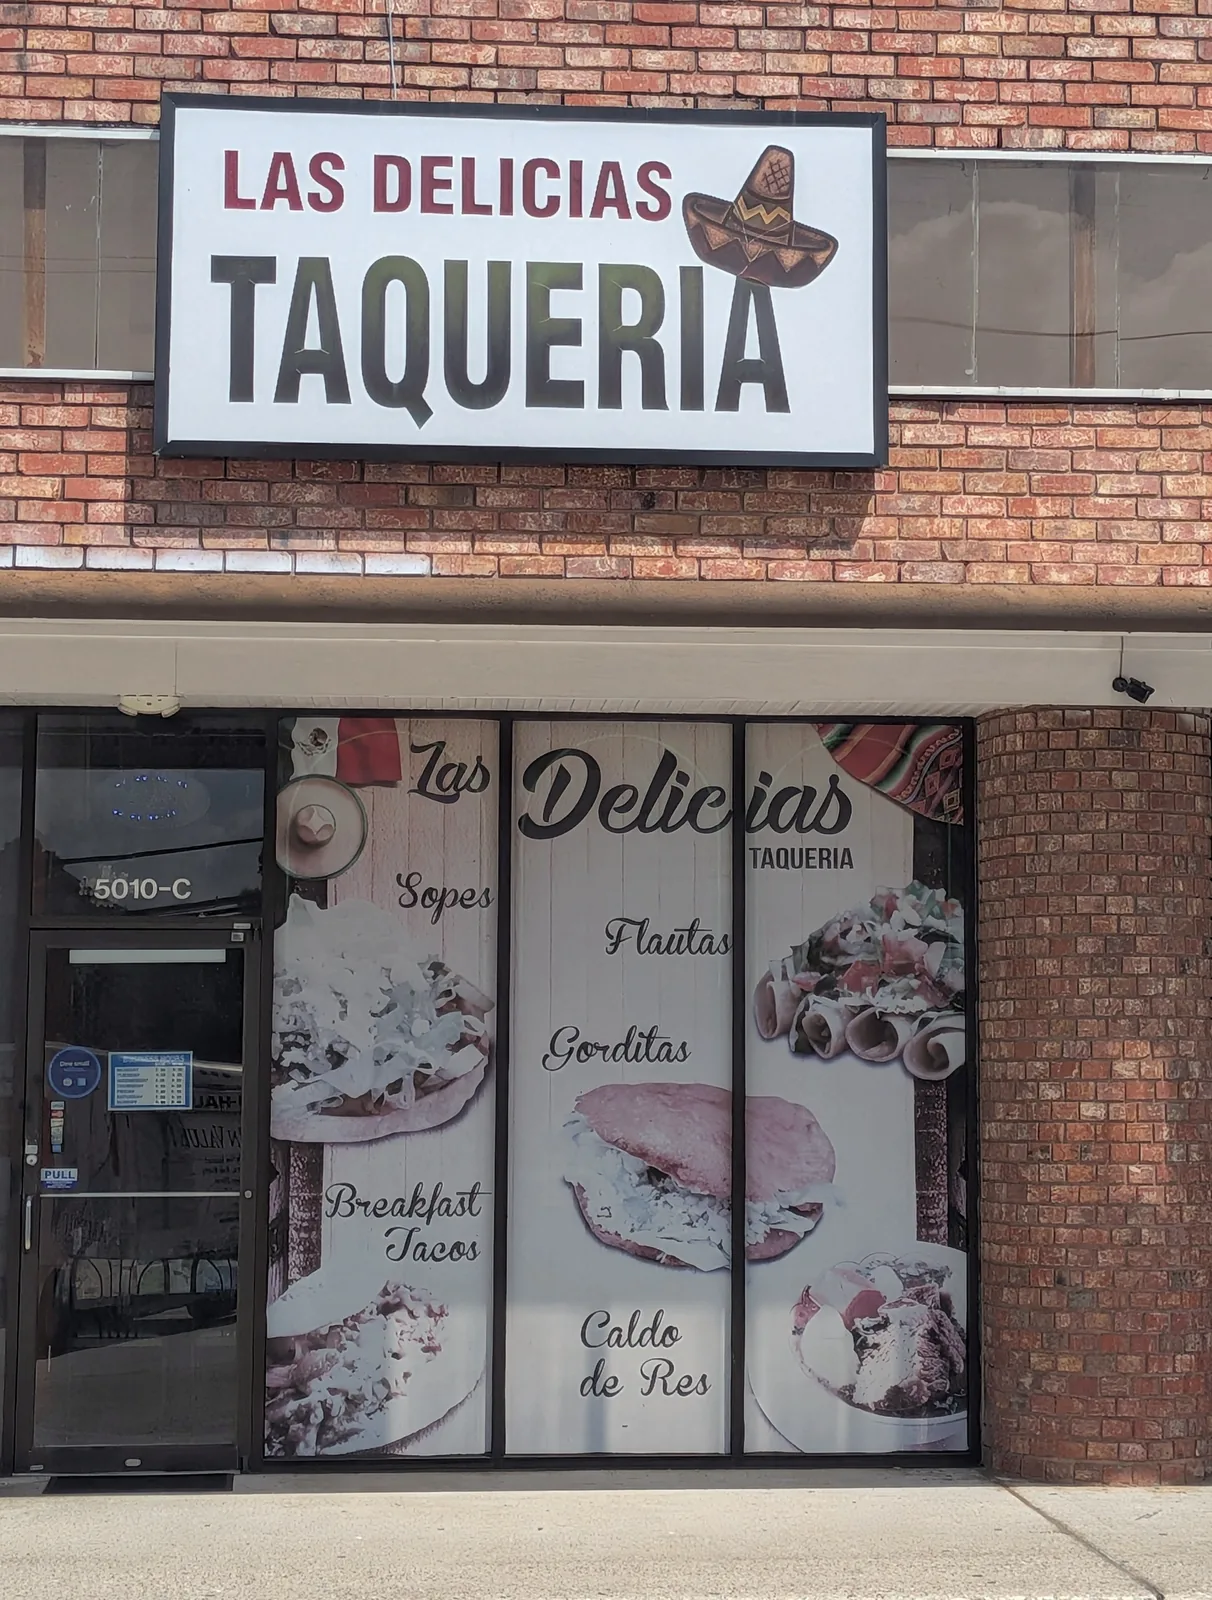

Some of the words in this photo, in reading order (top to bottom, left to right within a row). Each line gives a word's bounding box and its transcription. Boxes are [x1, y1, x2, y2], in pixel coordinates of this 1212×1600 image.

[225, 150, 345, 212] LAS
[374, 155, 672, 221] DELICIAS
[211, 255, 791, 429] TAQUERIA
[407, 741, 491, 804] Las
[518, 748, 852, 840] Delicias
[749, 847, 854, 870] TAQUERIA
[93, 878, 192, 899] 5010-C
[396, 872, 495, 925] Sopes
[605, 918, 733, 955] Flautas
[542, 1025, 692, 1071] Gorditas
[44, 1170, 75, 1179] PULL
[325, 1182, 492, 1225] Breakfast
[385, 1226, 480, 1262] Tacos
[580, 1309, 682, 1349] Caldo
[580, 1358, 623, 1397] de
[640, 1358, 711, 1397] Res
